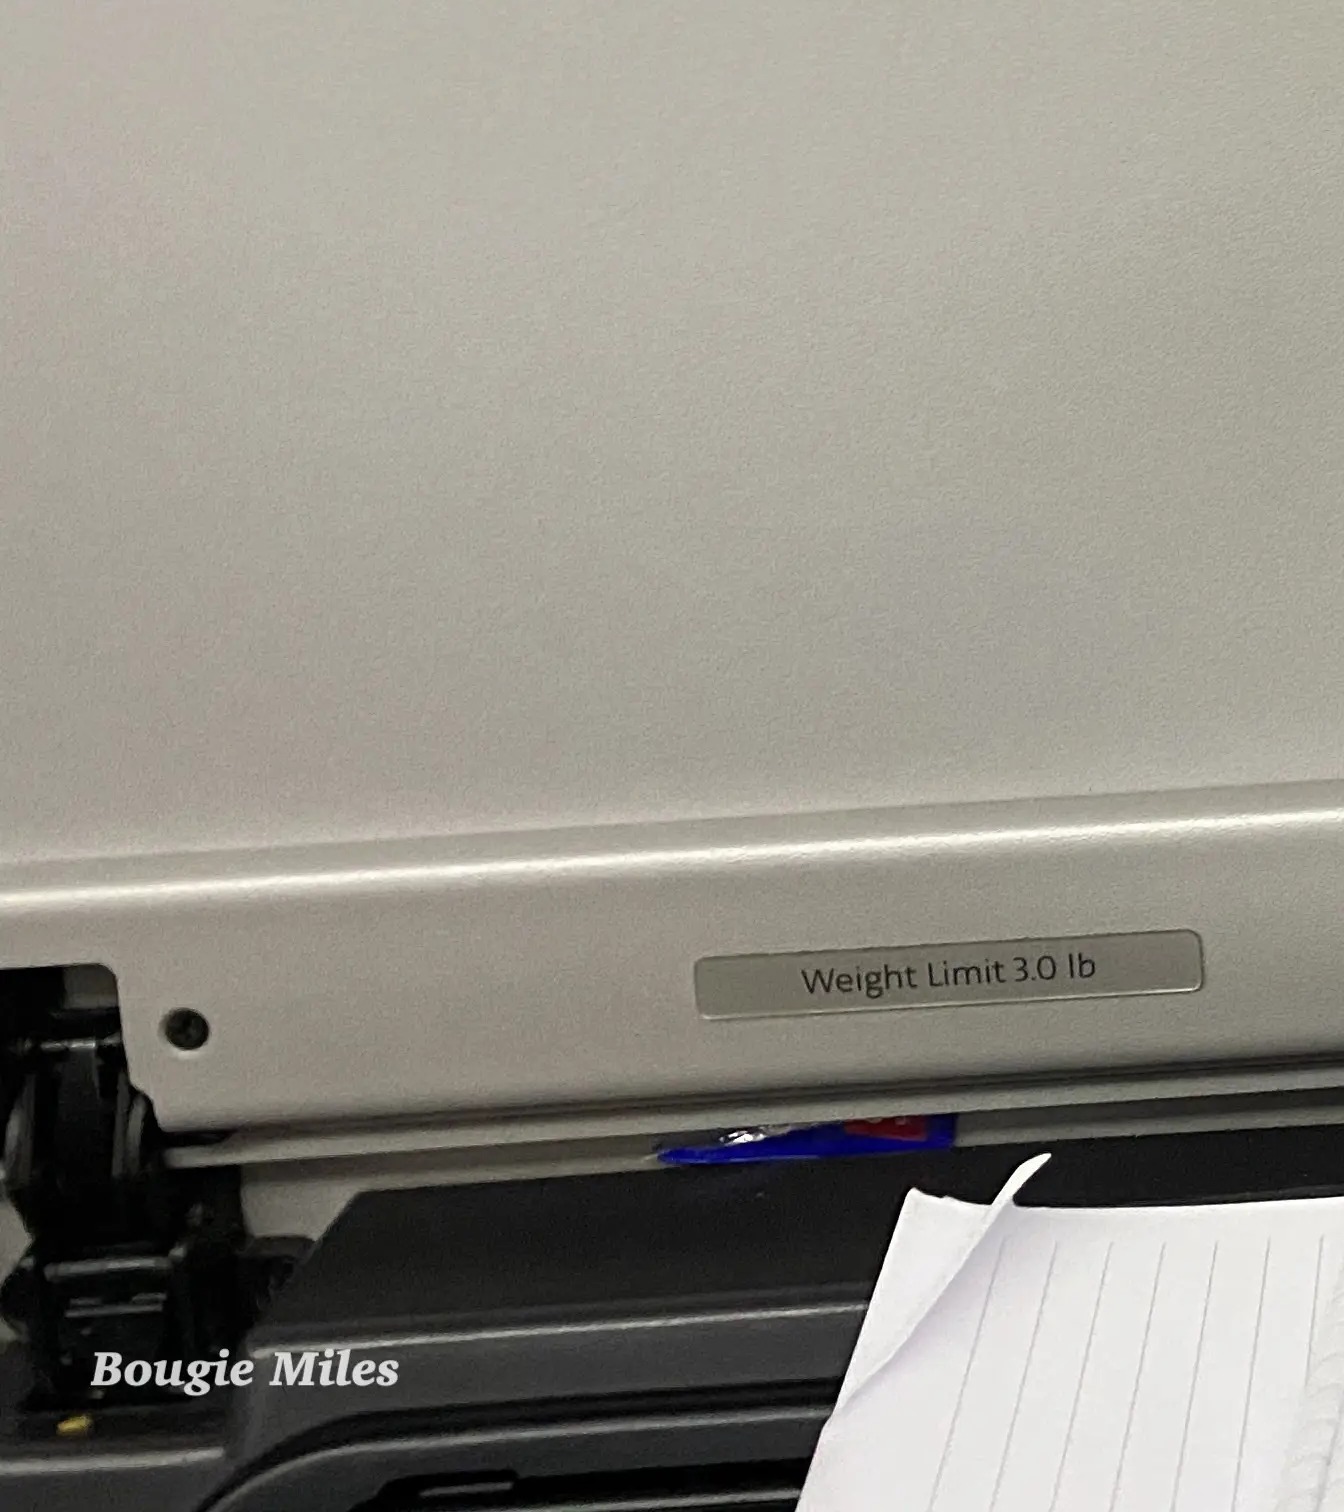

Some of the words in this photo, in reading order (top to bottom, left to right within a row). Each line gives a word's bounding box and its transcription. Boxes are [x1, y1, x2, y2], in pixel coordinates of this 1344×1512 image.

[800, 963, 919, 1000] Weight
[927, 959, 1006, 988] Limit
[1012, 954, 1057, 983] 3.0
[1067, 952, 1097, 979] lb
